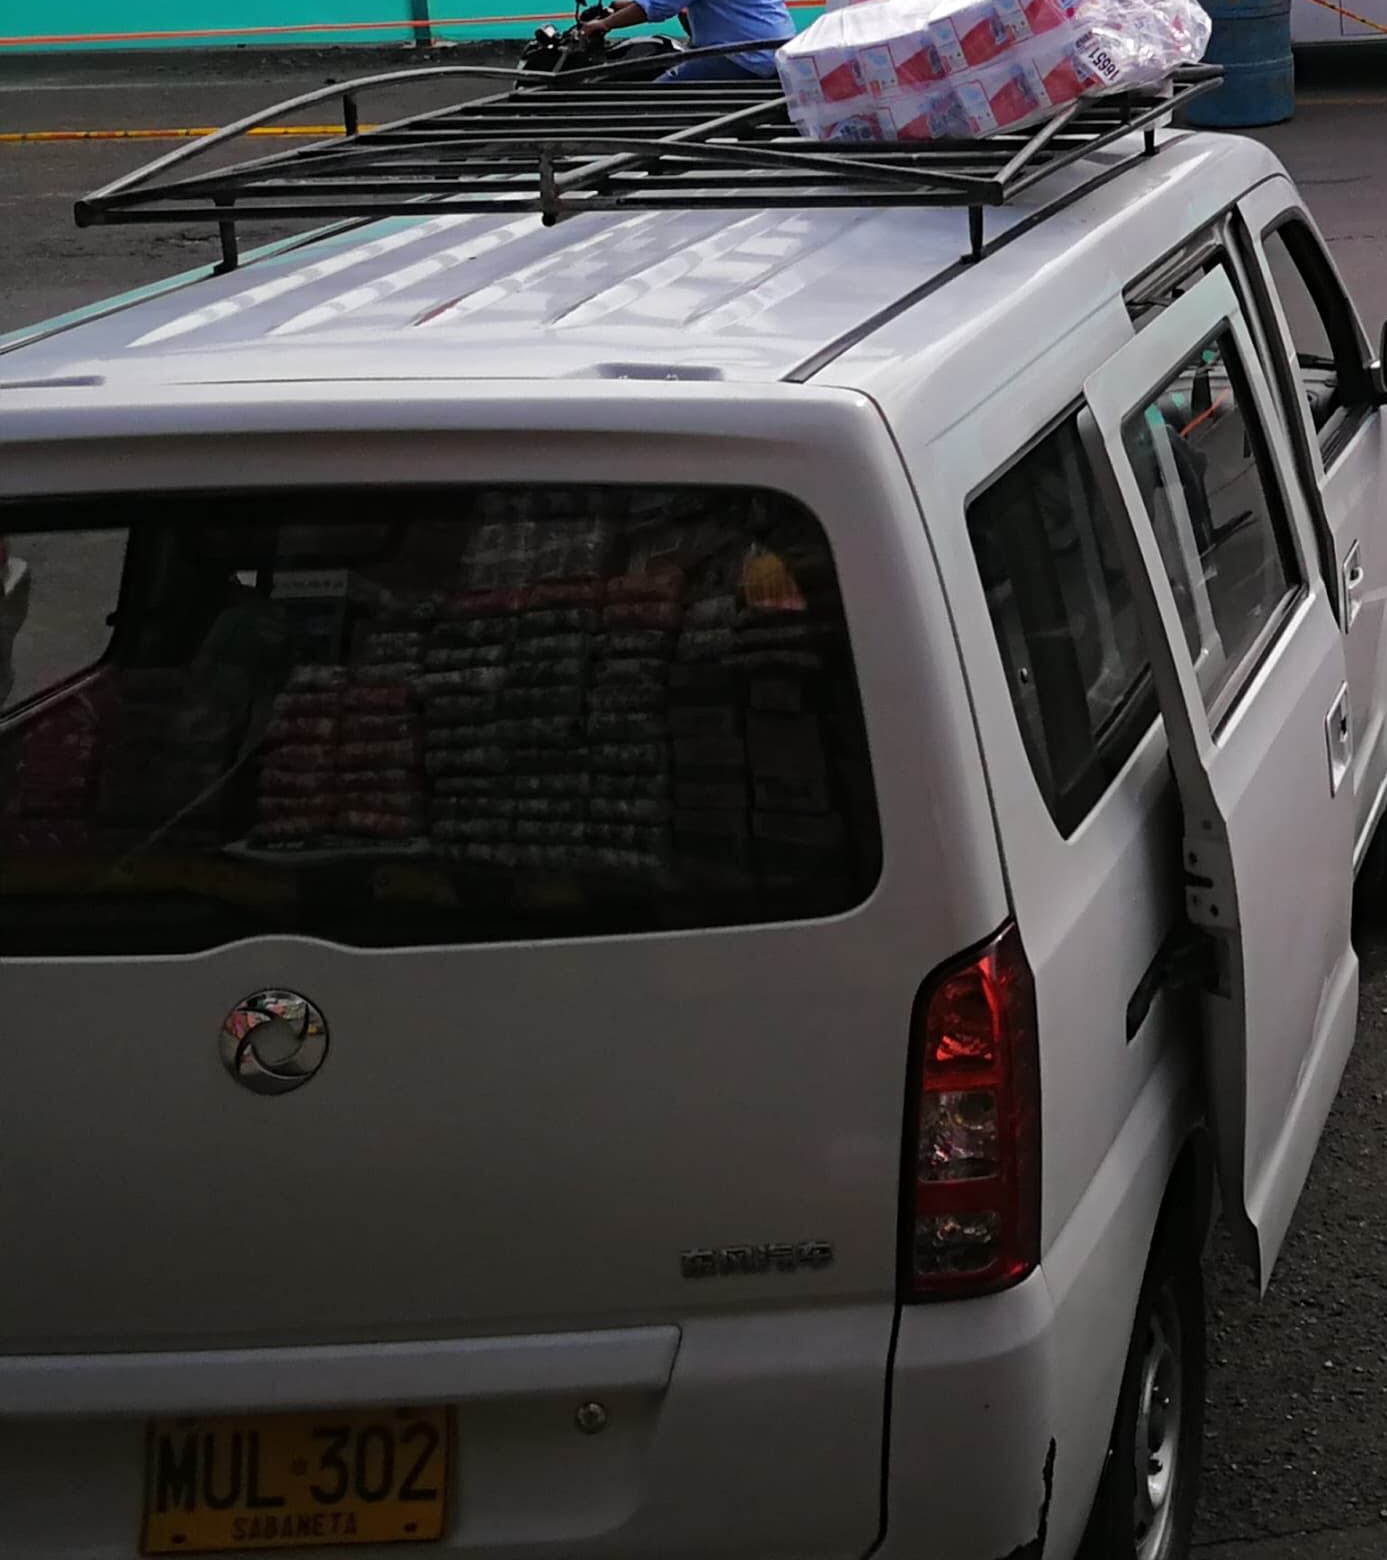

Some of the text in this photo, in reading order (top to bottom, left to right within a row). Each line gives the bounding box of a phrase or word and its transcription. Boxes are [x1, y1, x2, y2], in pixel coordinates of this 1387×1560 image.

[1088, 47, 1121, 81] 16651
[156, 1422, 440, 1513] MUL 302
[231, 1511, 358, 1540] SABANETA
